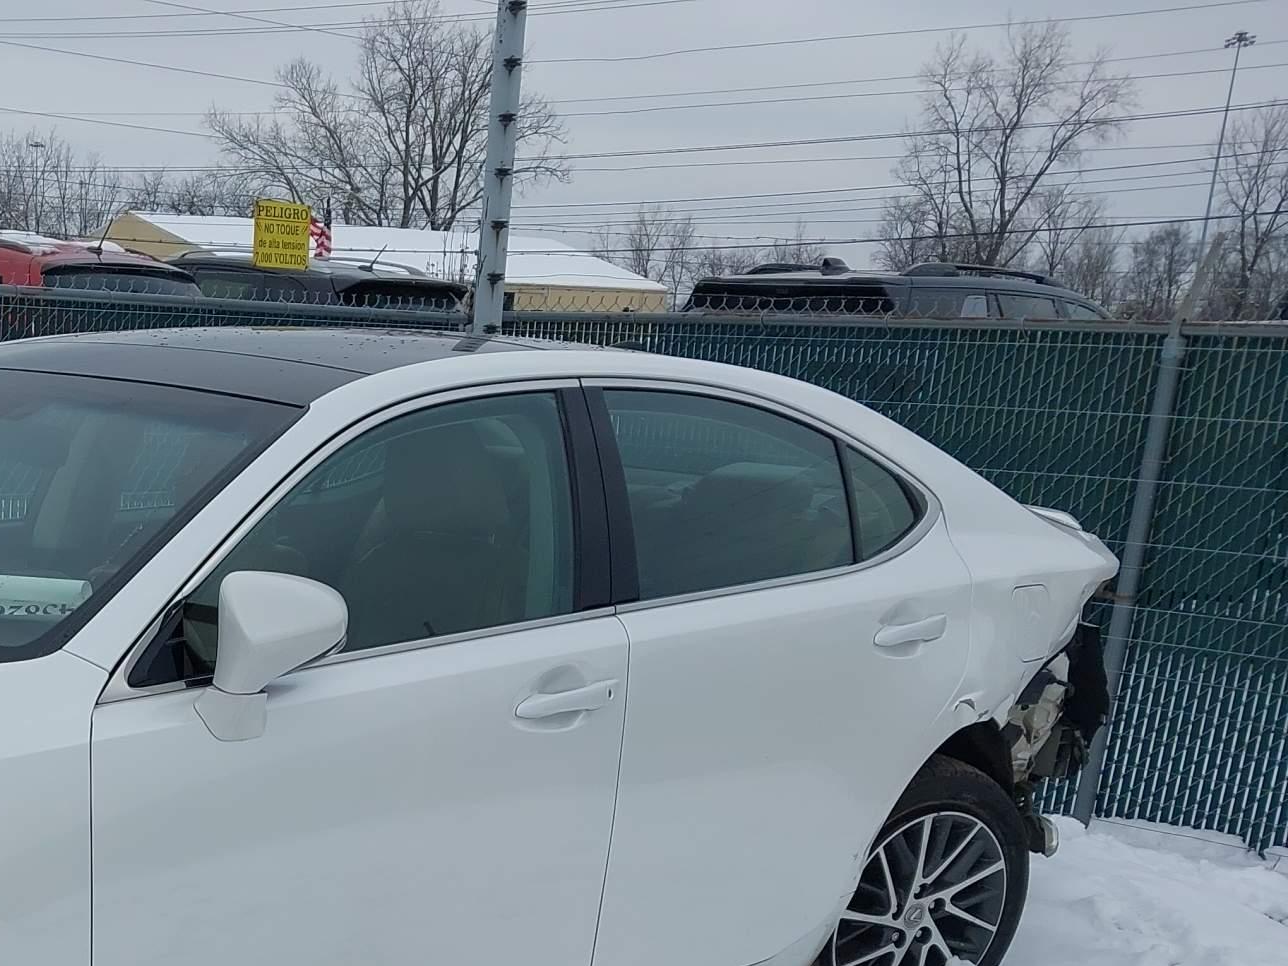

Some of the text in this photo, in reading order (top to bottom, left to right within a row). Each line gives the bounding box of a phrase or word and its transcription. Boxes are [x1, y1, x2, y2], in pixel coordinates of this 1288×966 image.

[257, 205, 309, 221] PELIGRO
[264, 223, 300, 236] NO TOQUE
[258, 239, 267, 248] de
[268, 239, 281, 249] alta
[274, 252, 307, 266] VOLTIOS
